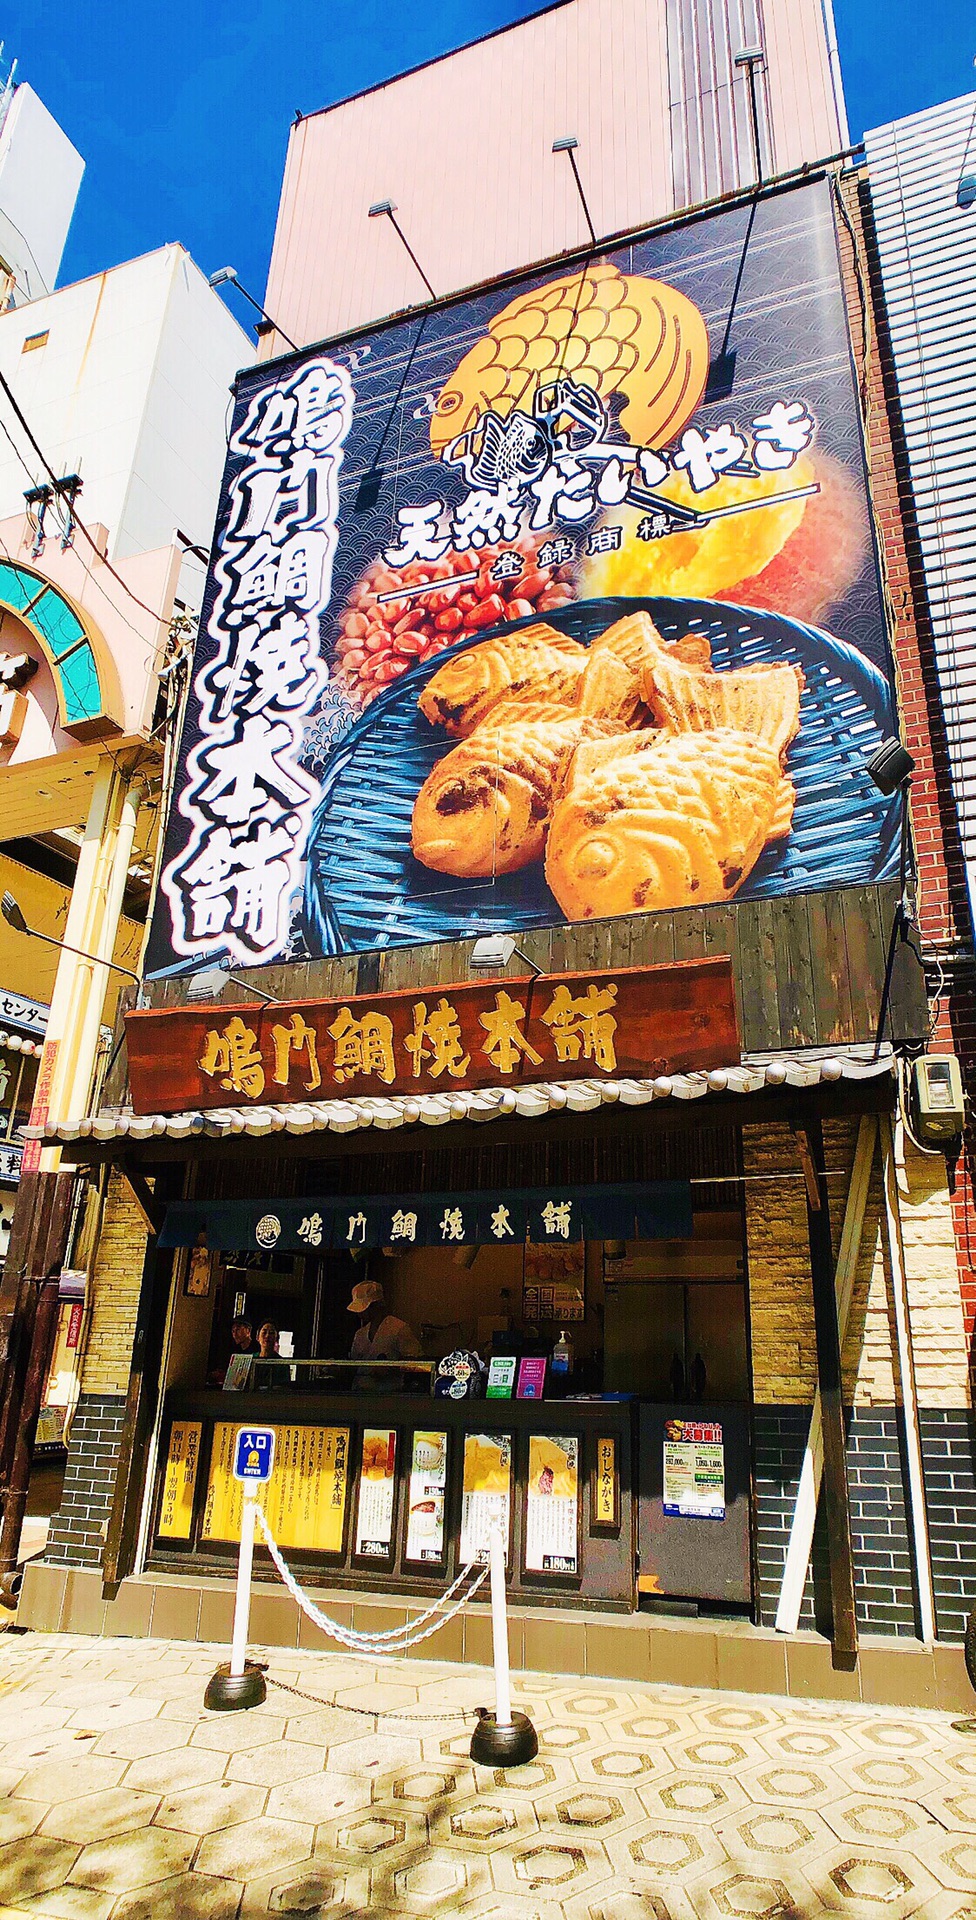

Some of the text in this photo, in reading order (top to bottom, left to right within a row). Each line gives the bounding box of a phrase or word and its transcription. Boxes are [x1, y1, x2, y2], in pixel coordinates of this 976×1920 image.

[381, 400, 815, 567] 天然たいやき
[492, 514, 673, 580] 登録商標
[182, 366, 346, 948] 鳴門鯛焼本舗
[2, 998, 49, 1024] センター
[197, 983, 618, 1099] 鳴門鯛焼本舗
[37, 1041, 57, 1105] 防犯カメラ作動中
[297, 1200, 573, 1246] 鳴門鯛焼本舗
[183, 1430, 199, 1484] 営業時間
[243, 1434, 267, 1450] 入口
[601, 1445, 612, 1512] おしながき
